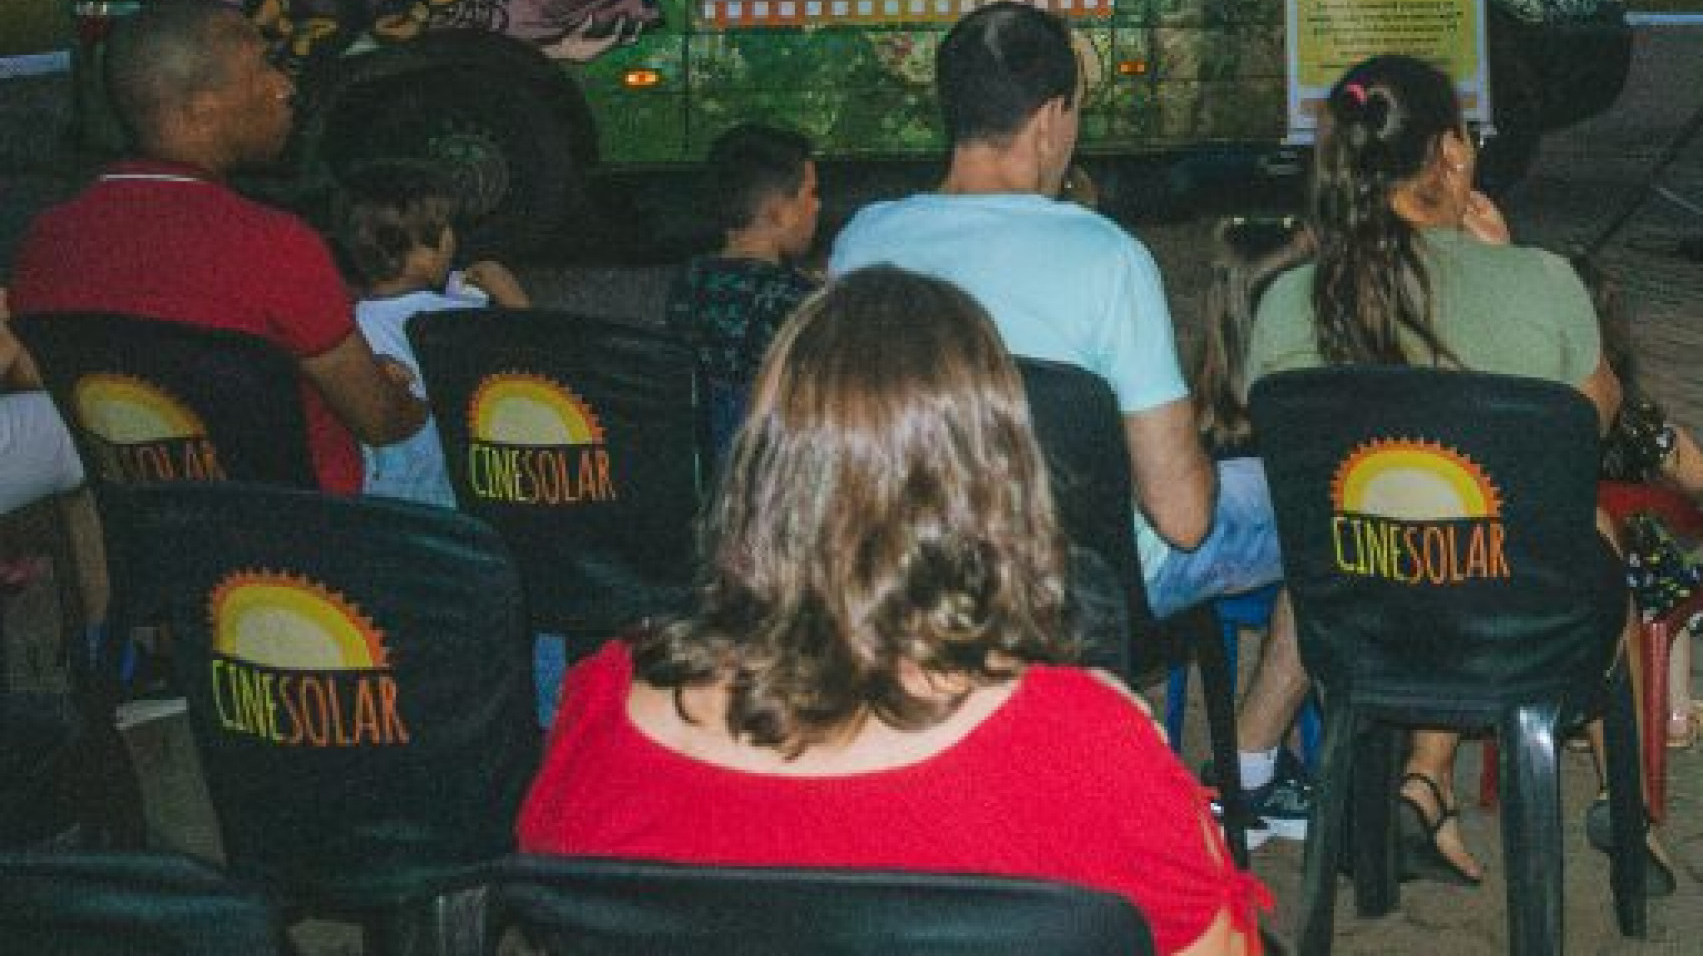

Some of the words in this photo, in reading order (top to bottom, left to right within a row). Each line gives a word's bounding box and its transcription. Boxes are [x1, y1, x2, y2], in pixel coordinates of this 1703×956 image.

[469, 444, 617, 505] CINESOLAR
[1331, 517, 1510, 584] CINESOLAR
[212, 659, 410, 747] CINESOLAR
